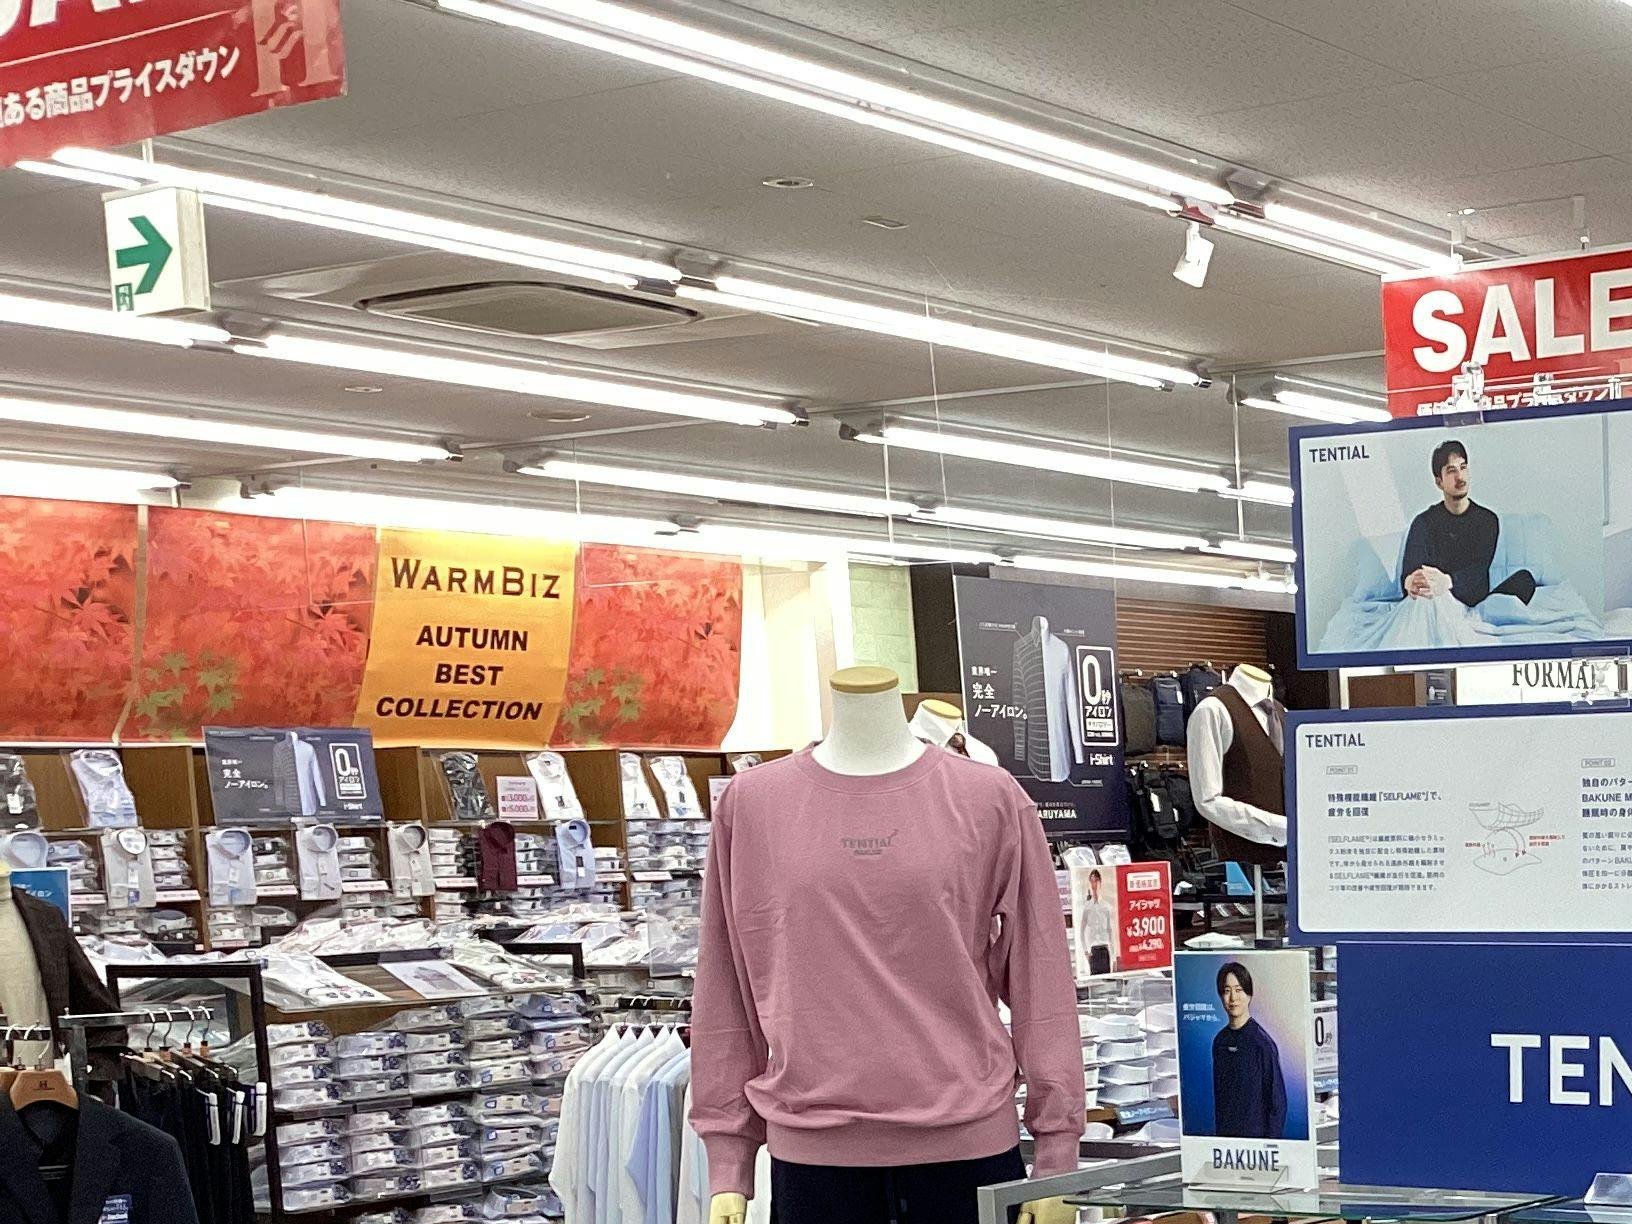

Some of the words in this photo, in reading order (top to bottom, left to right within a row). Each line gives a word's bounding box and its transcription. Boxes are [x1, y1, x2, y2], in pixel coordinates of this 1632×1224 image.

[0, 47, 240, 128] ある商品プライスダウン
[1309, 445, 1369, 463] TENTIAL
[416, 625, 528, 651] AUTUMN
[435, 663, 503, 686] BEST
[972, 682, 995, 699] 完全
[376, 697, 542, 720] COLLECTION
[1305, 733, 1365, 748] TENTIAL
[1582, 792, 1621, 802] BAKUNE
[1036, 808, 1077, 819] ARUYAMA
[1213, 1148, 1279, 1171] BAKUNE
